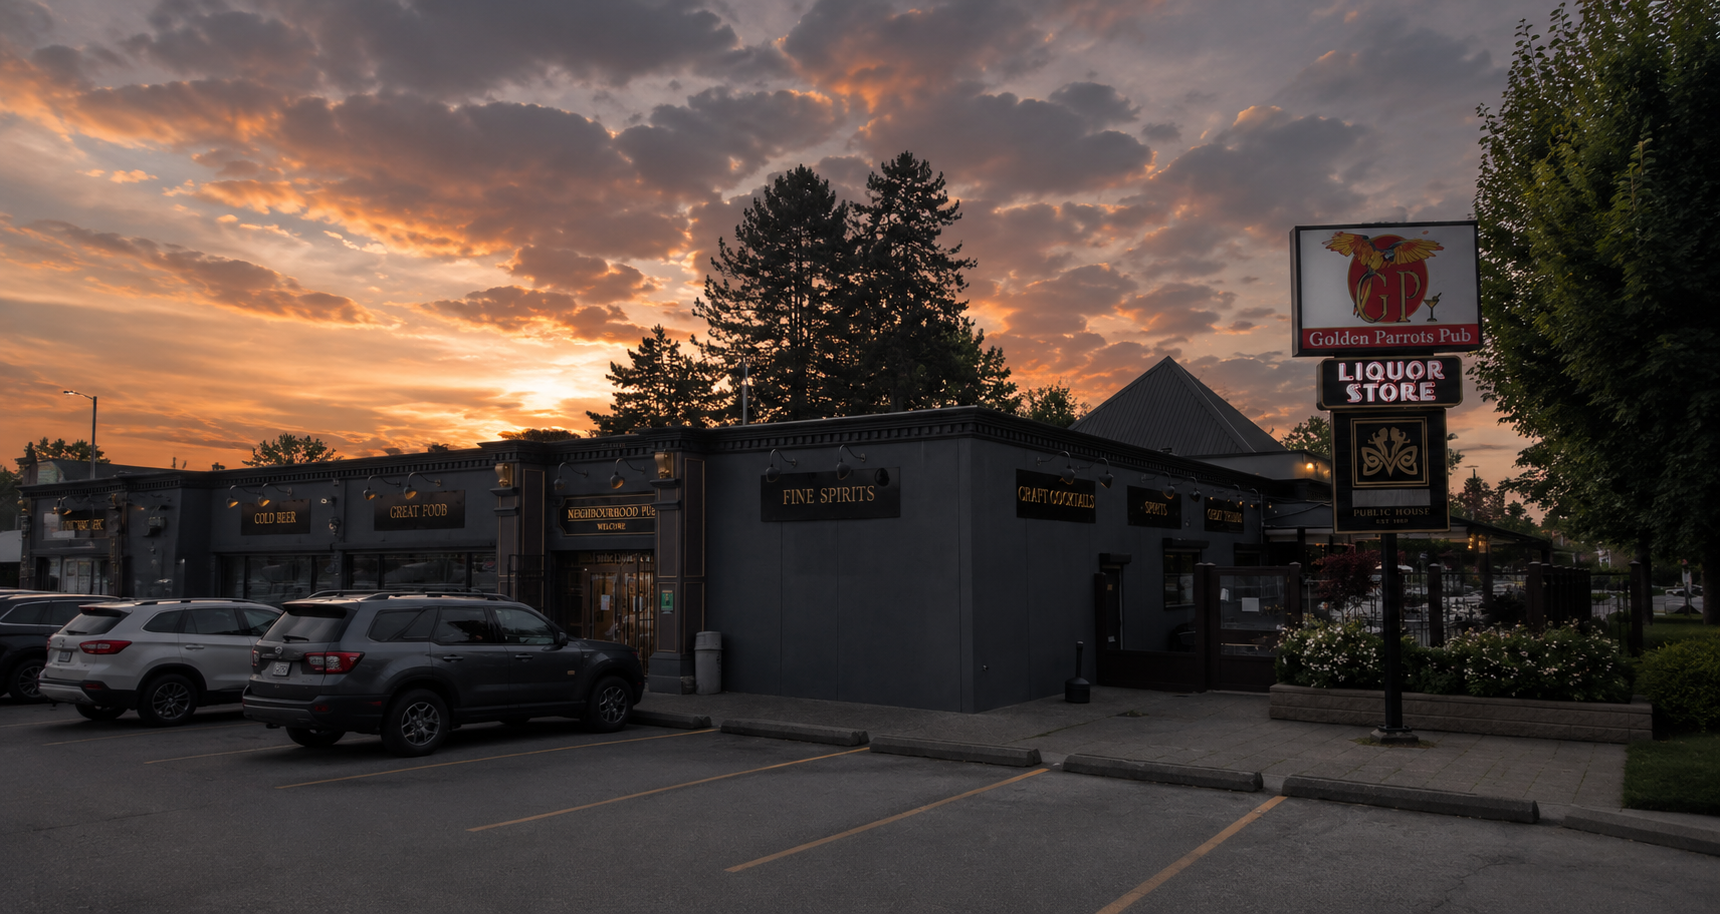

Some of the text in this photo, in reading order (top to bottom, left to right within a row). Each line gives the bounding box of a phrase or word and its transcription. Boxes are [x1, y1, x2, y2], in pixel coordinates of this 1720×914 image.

[1356, 270, 1421, 323] GP
[1309, 328, 1471, 347] Golden Parrots Pub
[1338, 360, 1445, 382] LIQUOR
[1346, 381, 1436, 403] STORE
[782, 485, 875, 505] FINE SPIRITS
[1017, 485, 1049, 504] CRAFT
[254, 511, 297, 524] COLD BEER
[390, 504, 420, 519] GREAT
[1353, 507, 1431, 517] PUBLIC HOUSE
